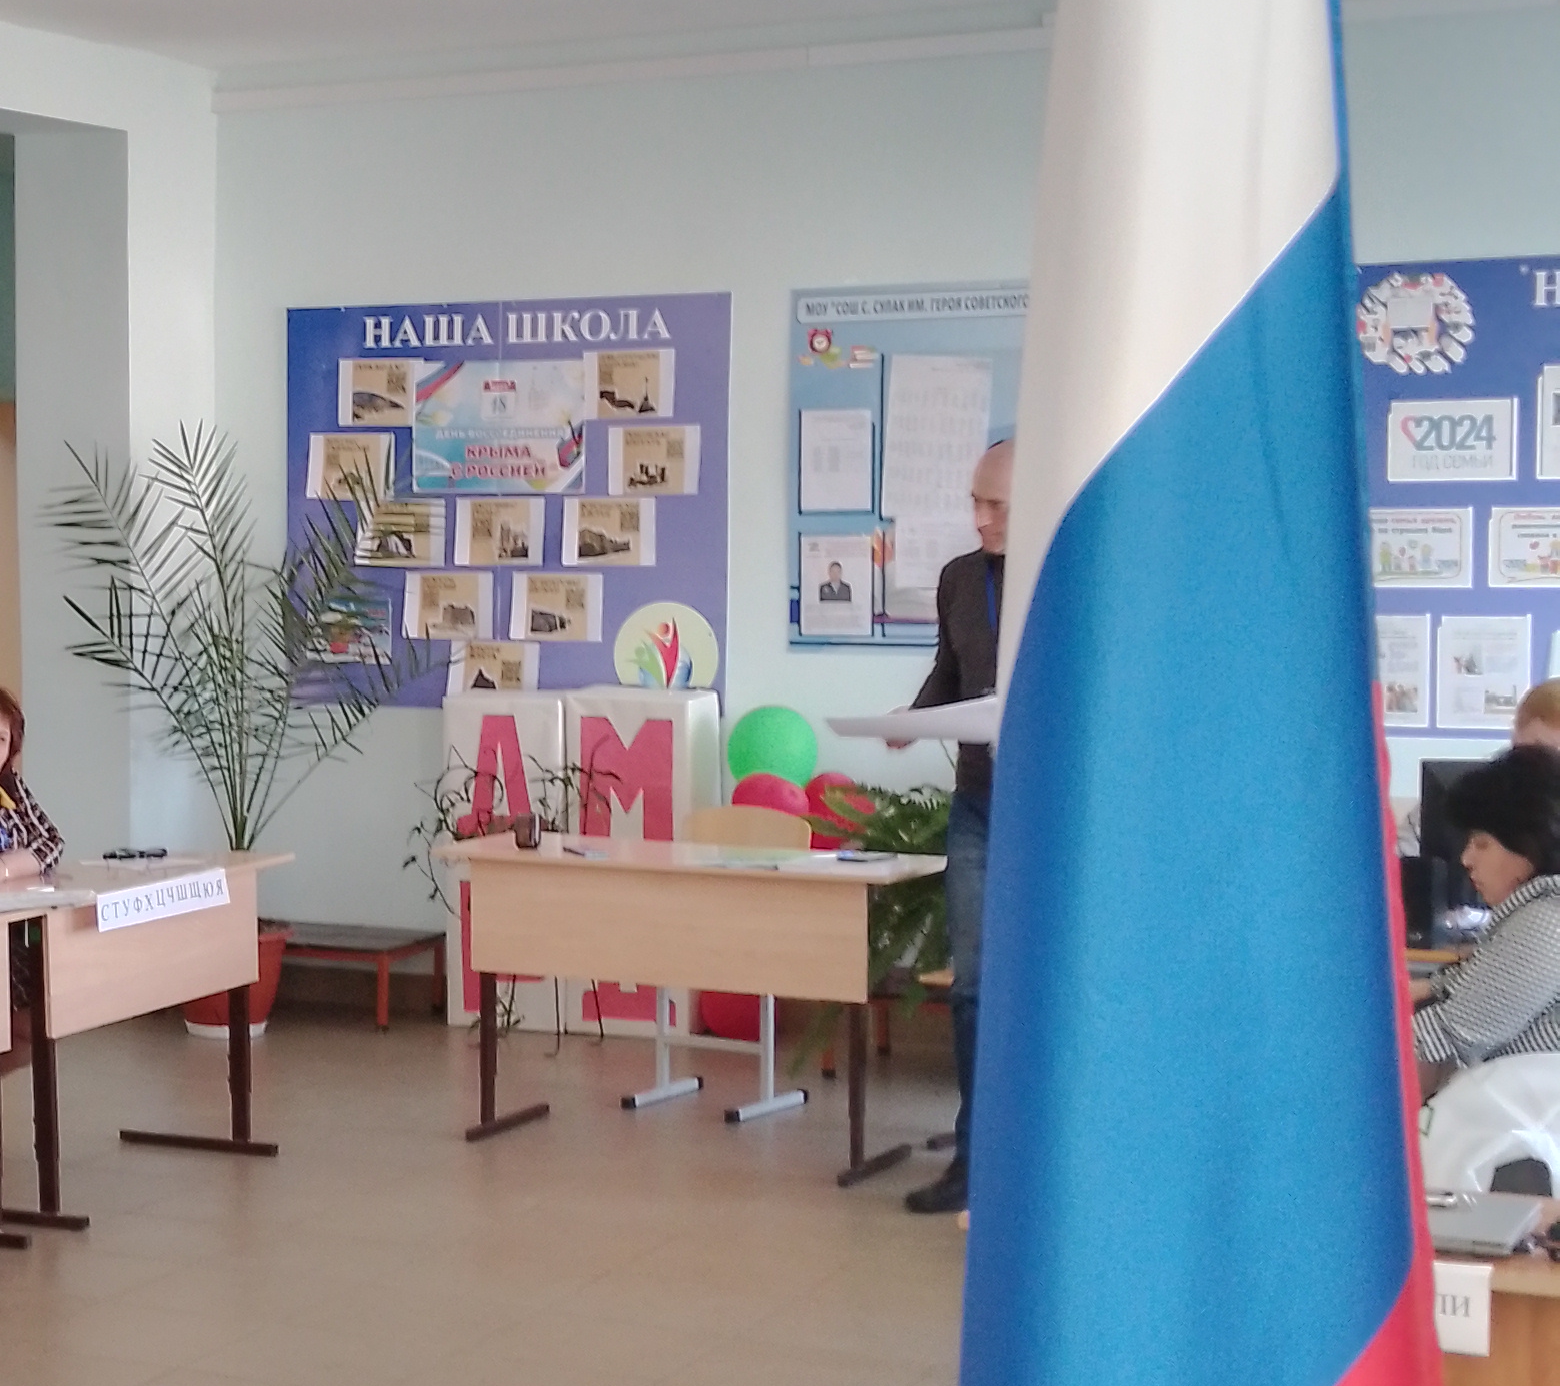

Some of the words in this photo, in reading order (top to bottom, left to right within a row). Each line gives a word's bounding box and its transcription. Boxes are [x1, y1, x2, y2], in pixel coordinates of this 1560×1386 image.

[363, 313, 493, 349] НАША
[507, 308, 671, 344] ШКОЛА
[465, 444, 532, 459] КРЫМА
[1414, 414, 1496, 452] 2024
